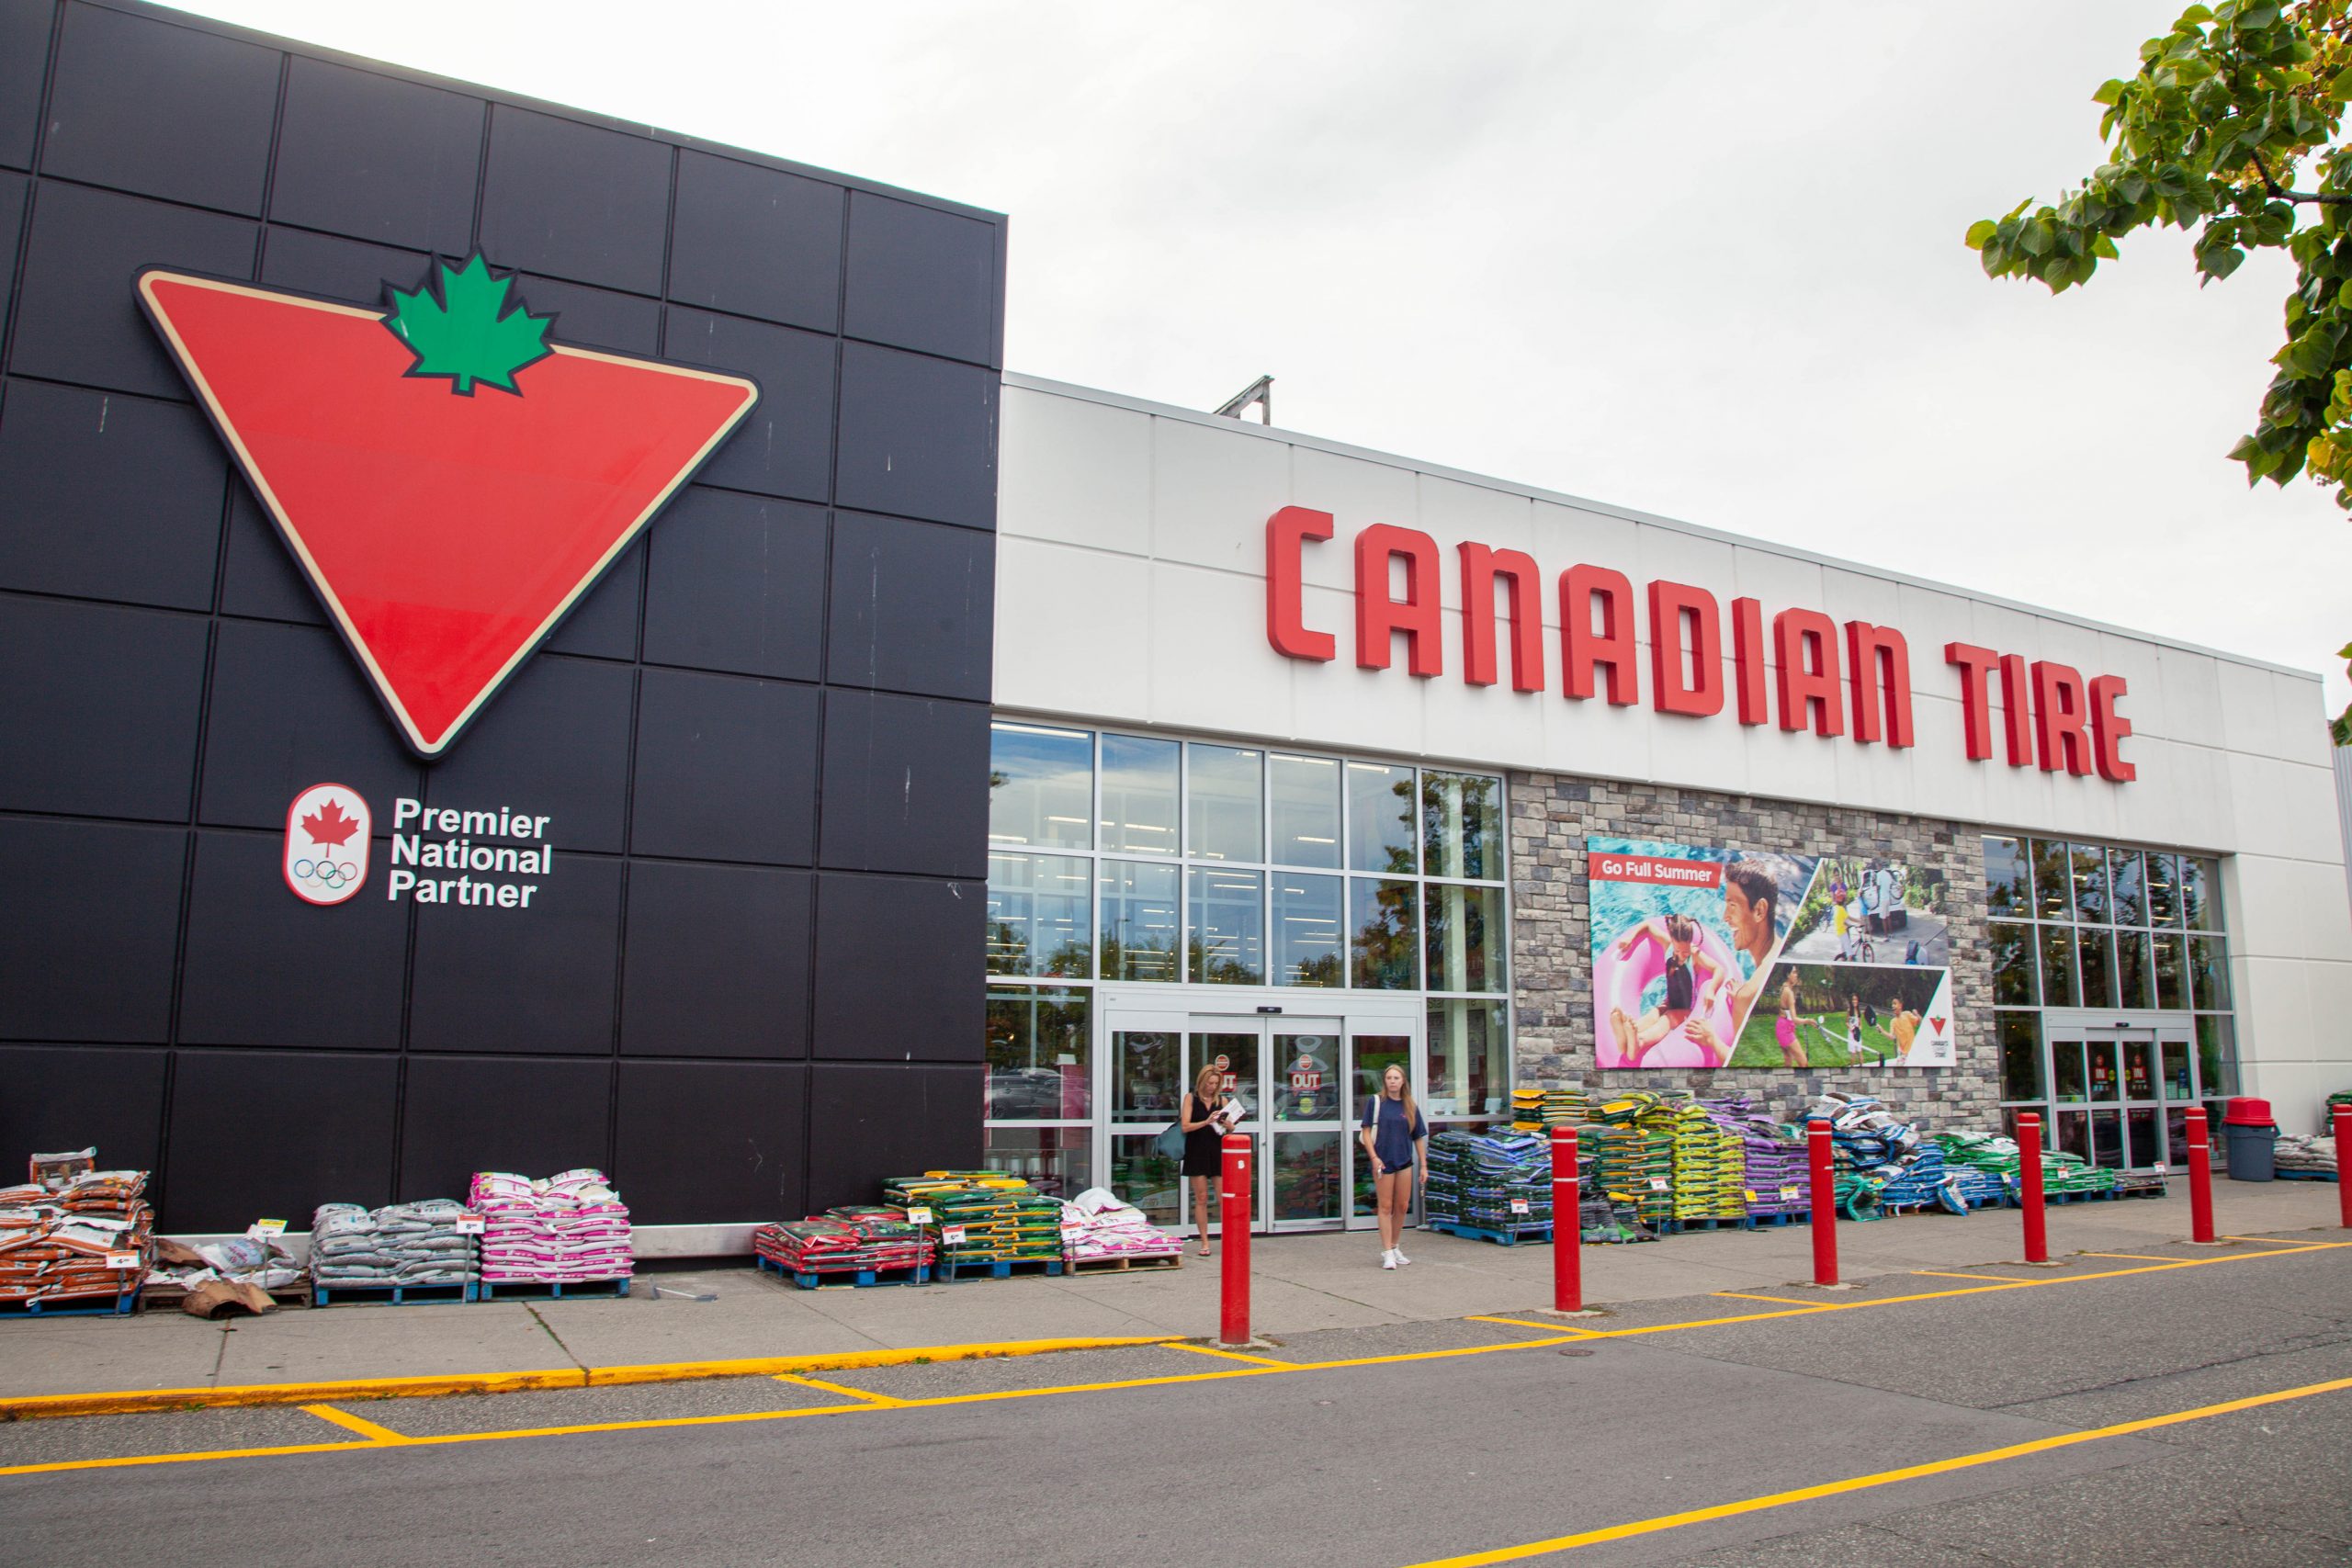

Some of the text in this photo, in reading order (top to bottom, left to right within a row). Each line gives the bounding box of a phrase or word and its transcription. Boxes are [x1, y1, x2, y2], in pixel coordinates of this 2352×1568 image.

[1266, 505, 2137, 783] CANADIAN TIRE
[393, 797, 551, 839] Premier
[390, 833, 552, 874] National
[1601, 860, 1713, 882] Go Full Summer
[388, 869, 537, 908] Partner
[1292, 1073, 1320, 1089] OUT
